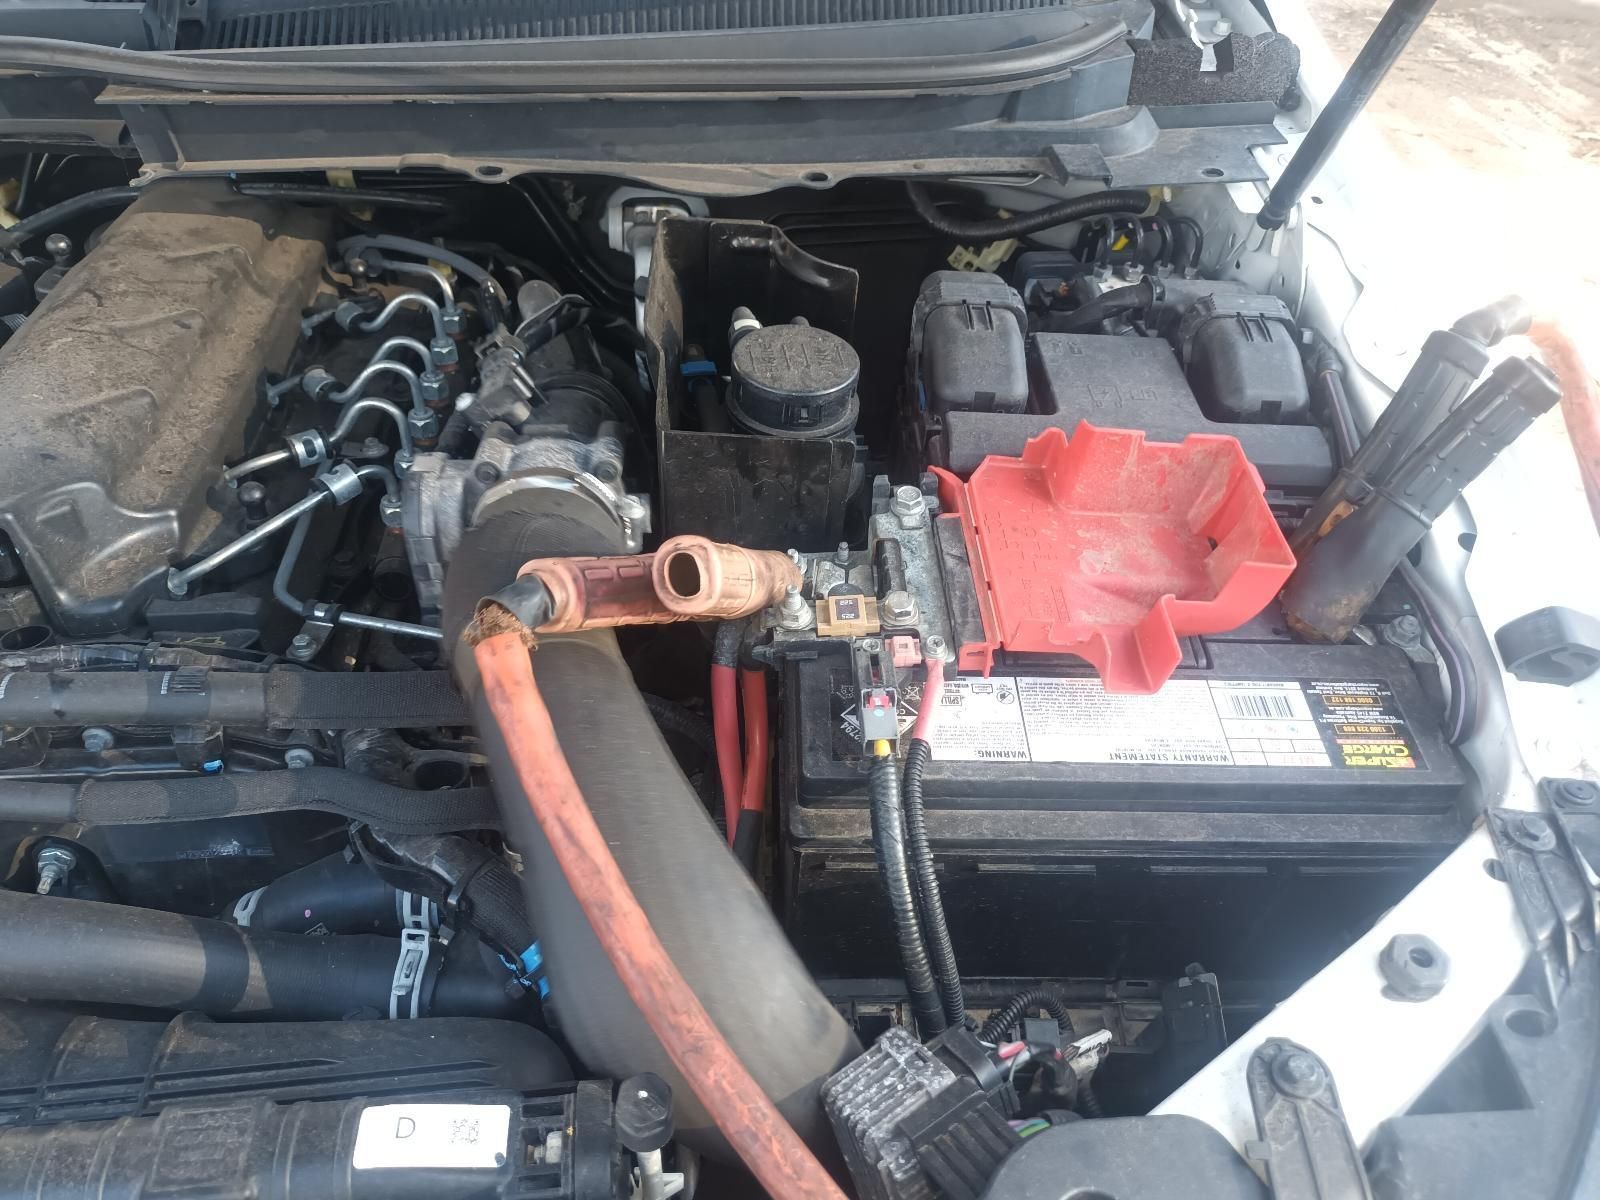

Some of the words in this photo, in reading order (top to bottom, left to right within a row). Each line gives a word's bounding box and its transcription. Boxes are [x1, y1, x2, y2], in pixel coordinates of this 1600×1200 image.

[1342, 744, 1409, 756] CHARGE
[1108, 752, 1169, 761] STATEMENT
[1172, 753, 1229, 762] WARRANTY
[1344, 756, 1410, 768] SUPER
[395, 1117, 416, 1139] D
